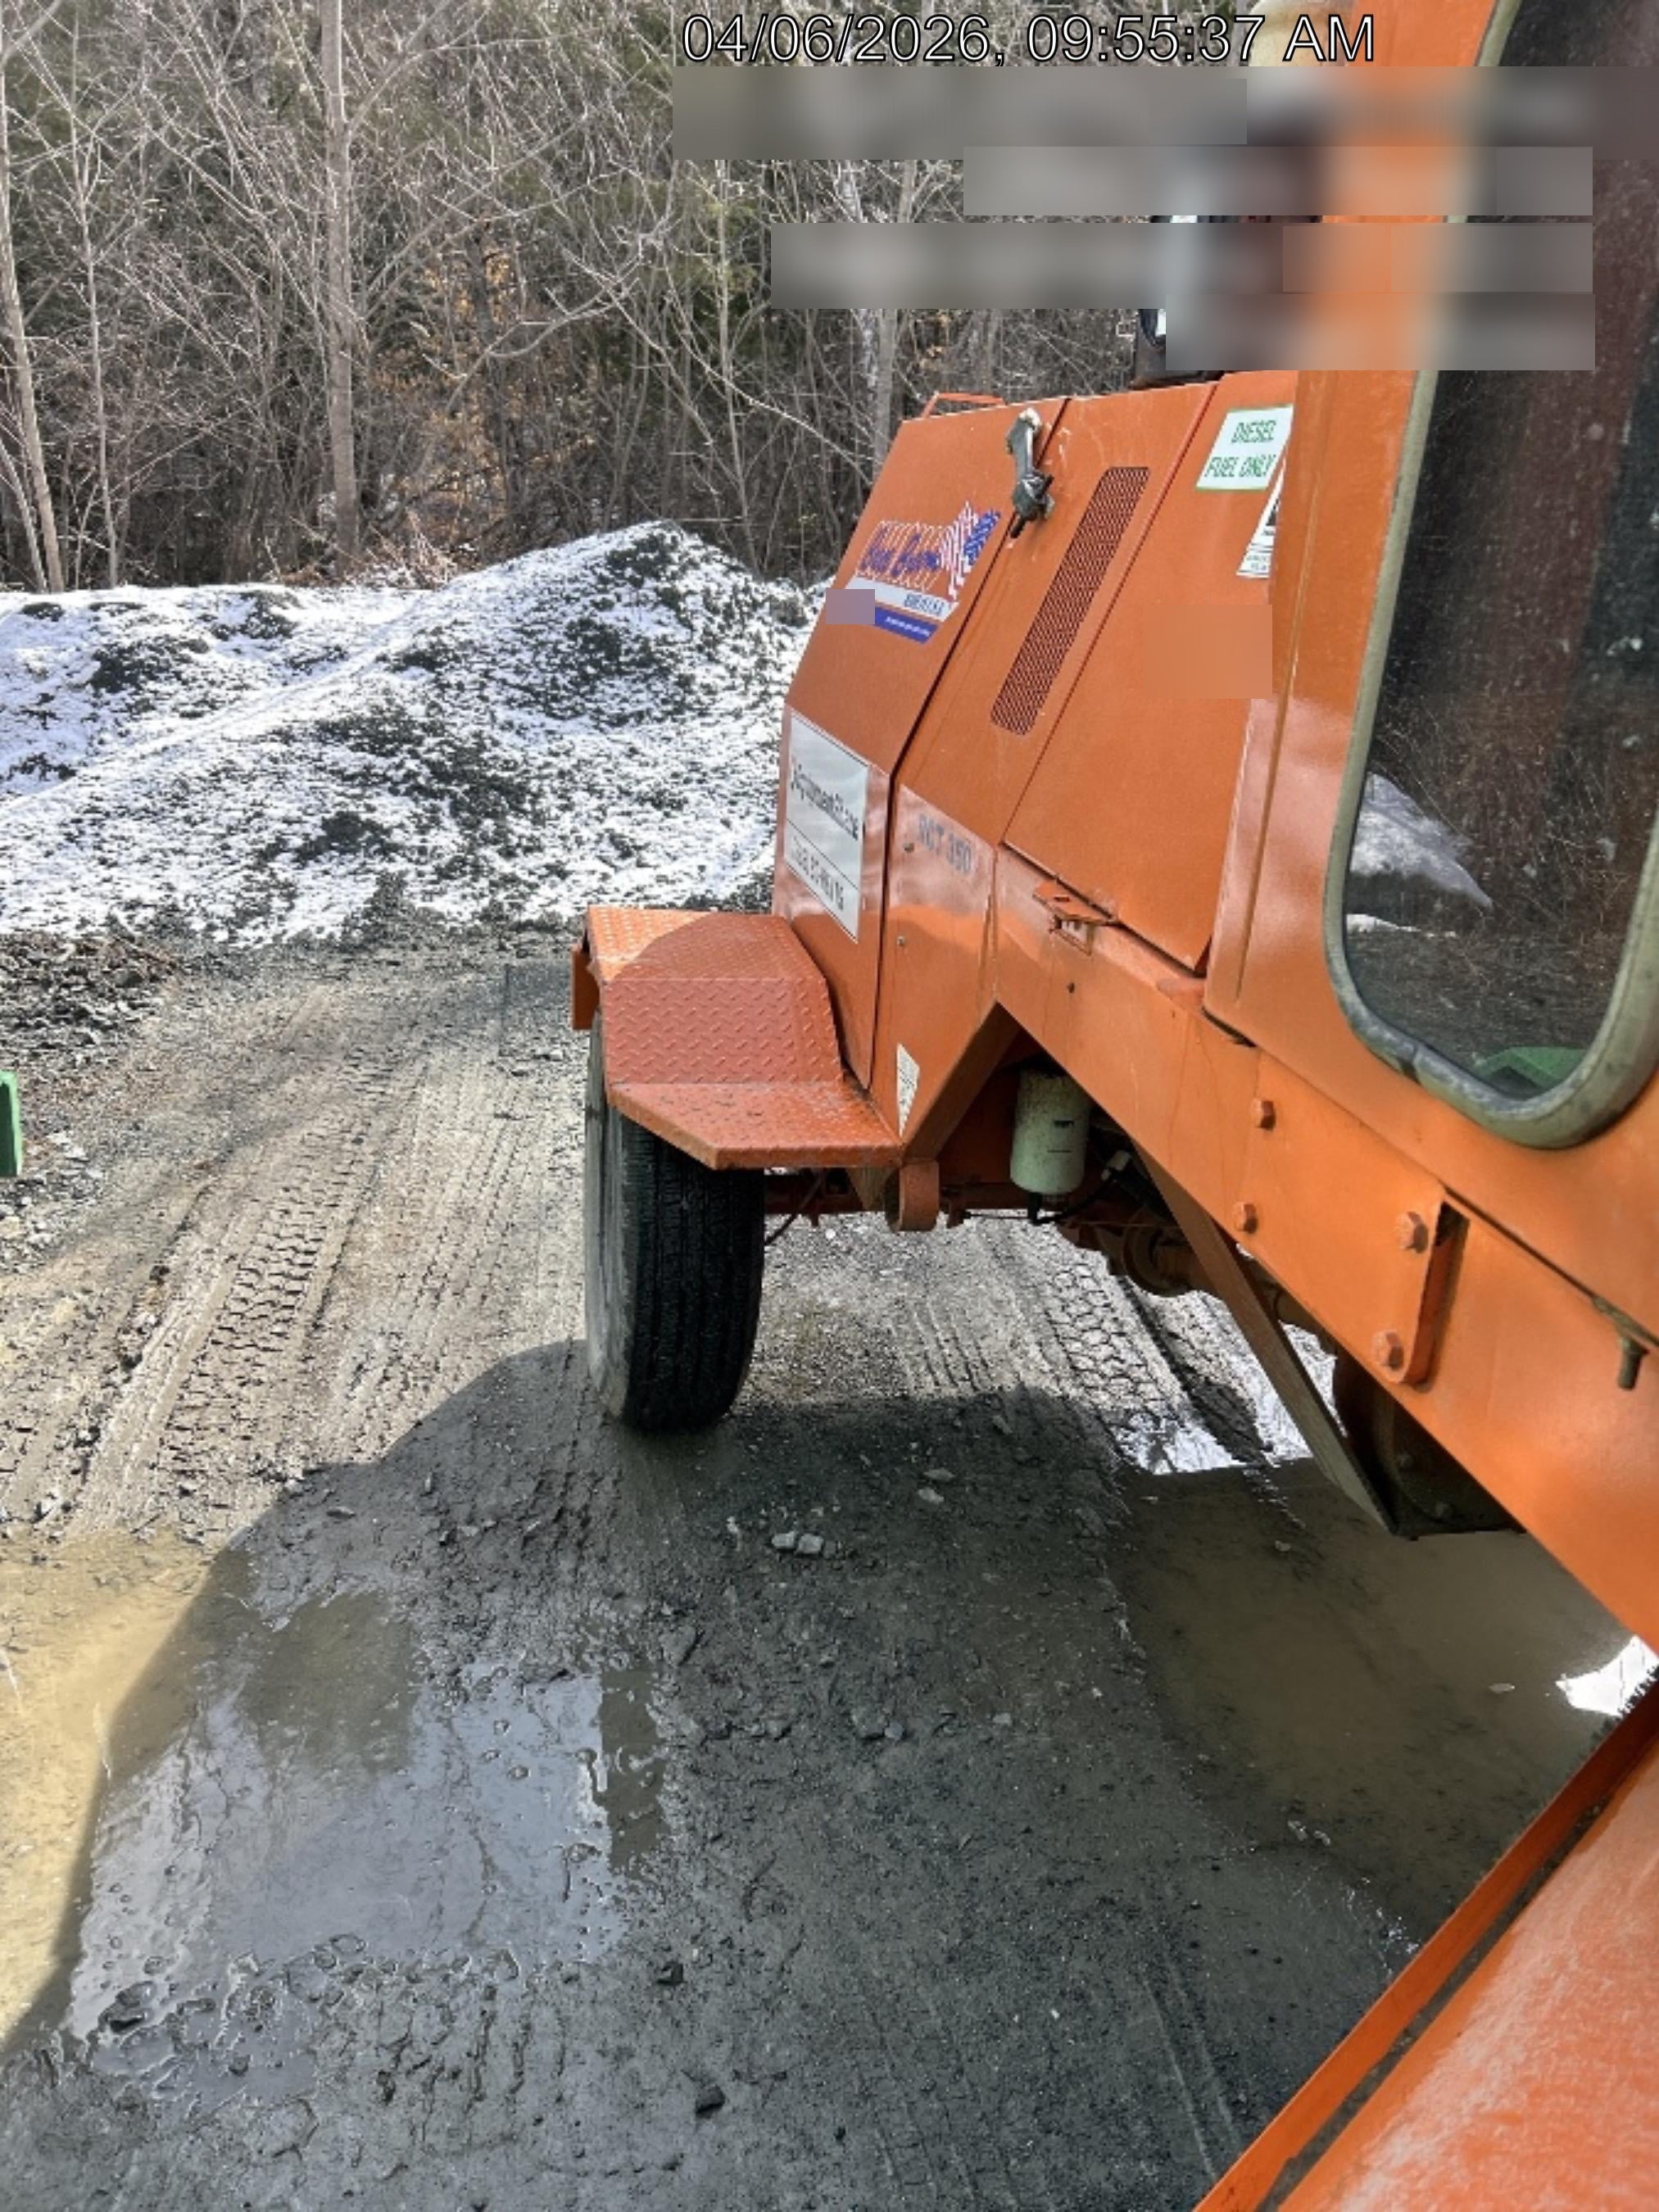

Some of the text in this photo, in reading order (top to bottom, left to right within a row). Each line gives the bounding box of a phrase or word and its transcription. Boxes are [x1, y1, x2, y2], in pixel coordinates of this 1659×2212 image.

[1231, 419, 1276, 443] DIESEL
[1204, 454, 1276, 478] FUEL ONLY
